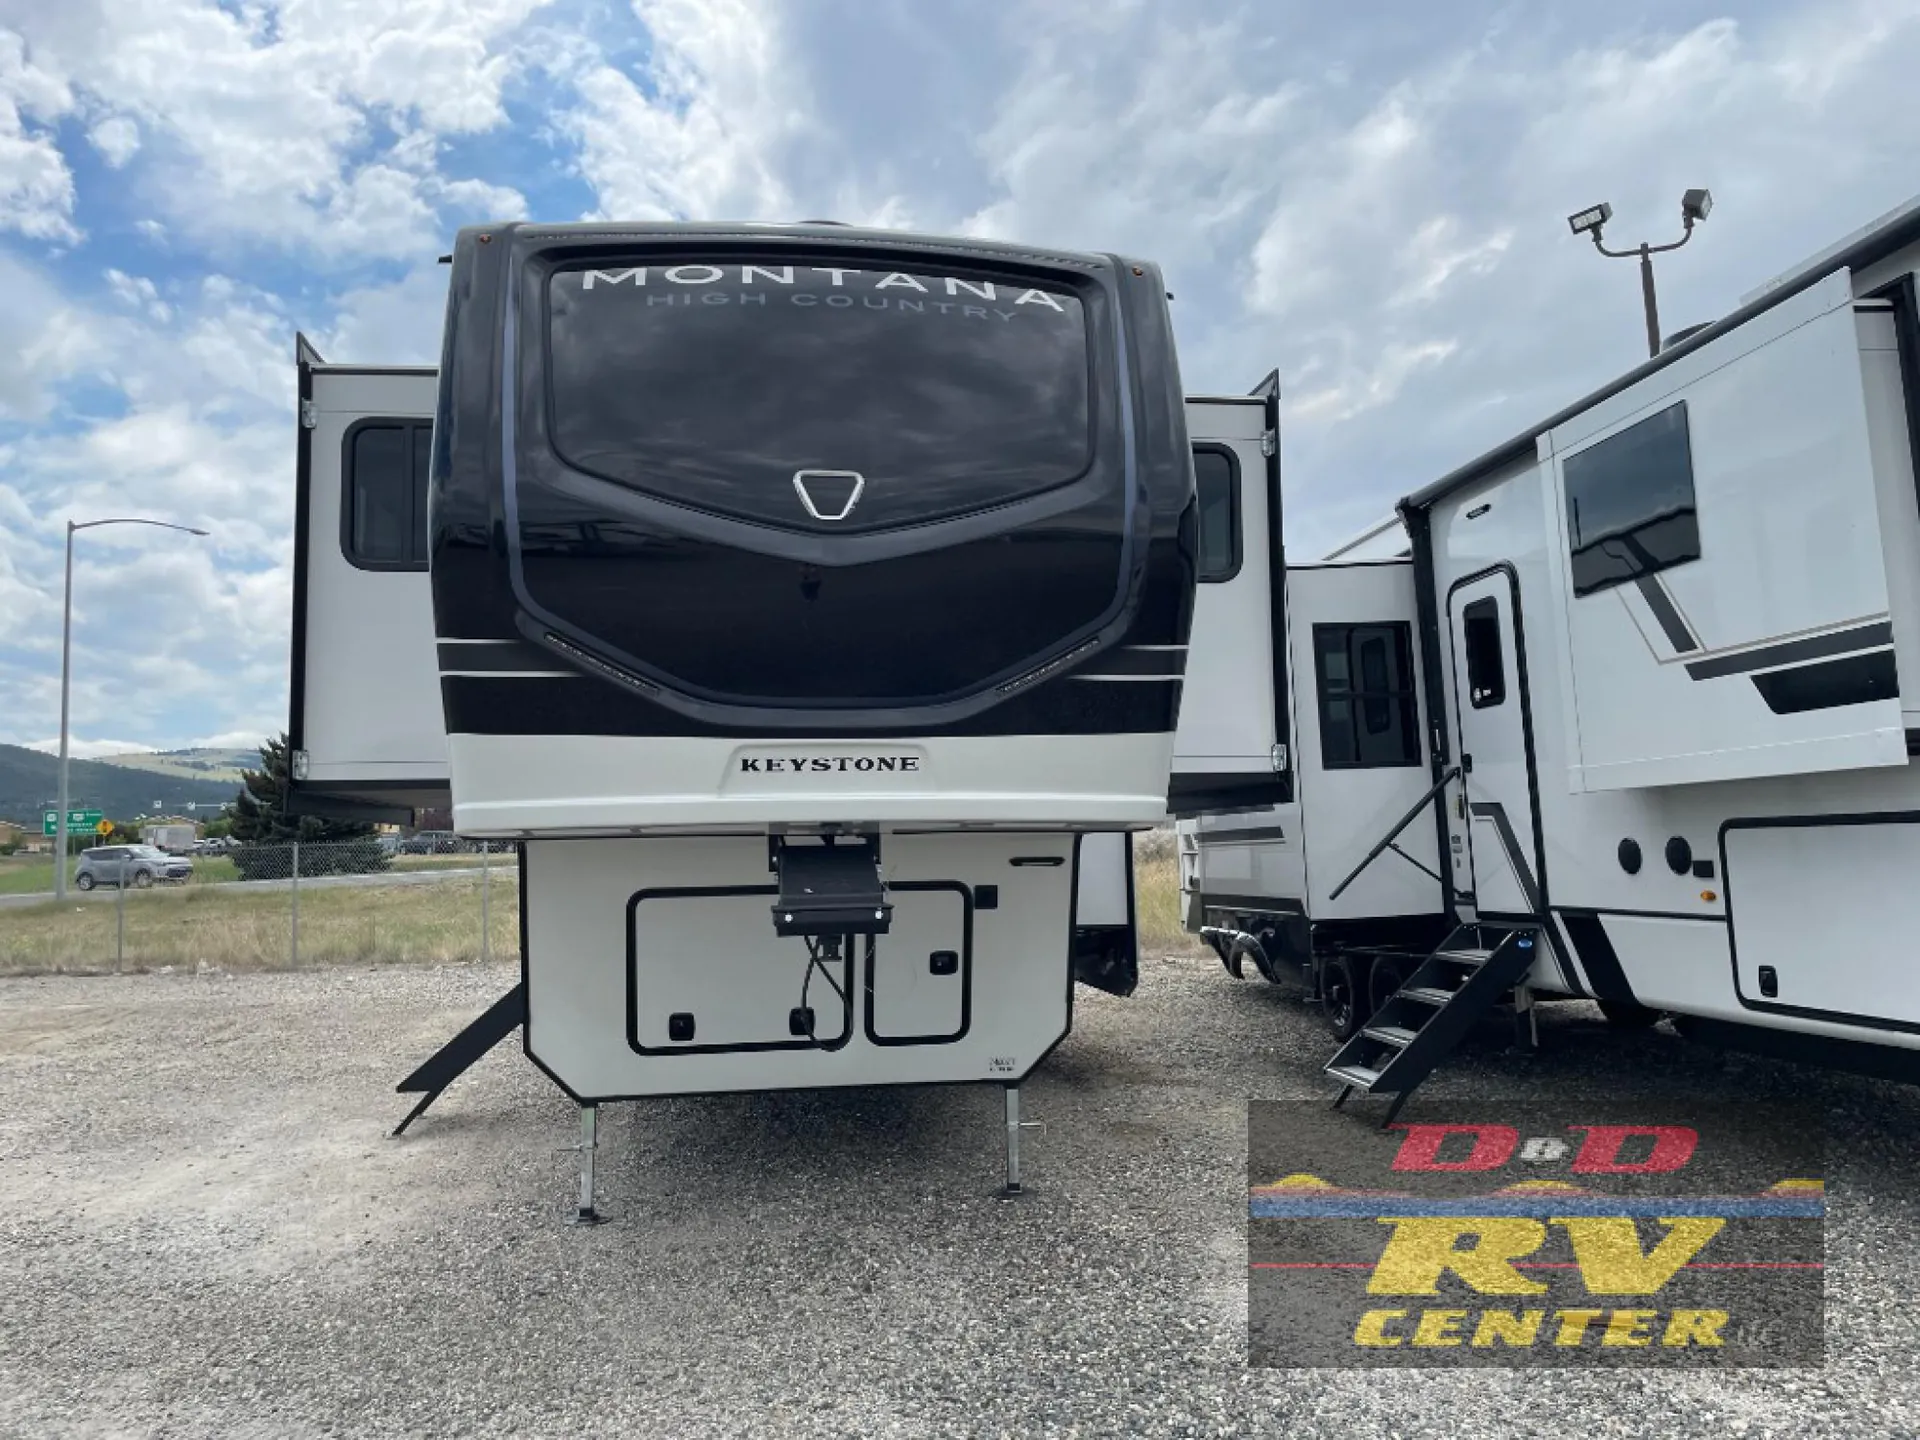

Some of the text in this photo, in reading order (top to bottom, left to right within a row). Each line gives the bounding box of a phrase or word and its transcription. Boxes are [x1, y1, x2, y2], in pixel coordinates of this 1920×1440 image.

[582, 265, 1065, 312] MONTANA
[646, 292, 1017, 322] HIGH COUNTRY
[740, 757, 920, 772] KEYSTONE
